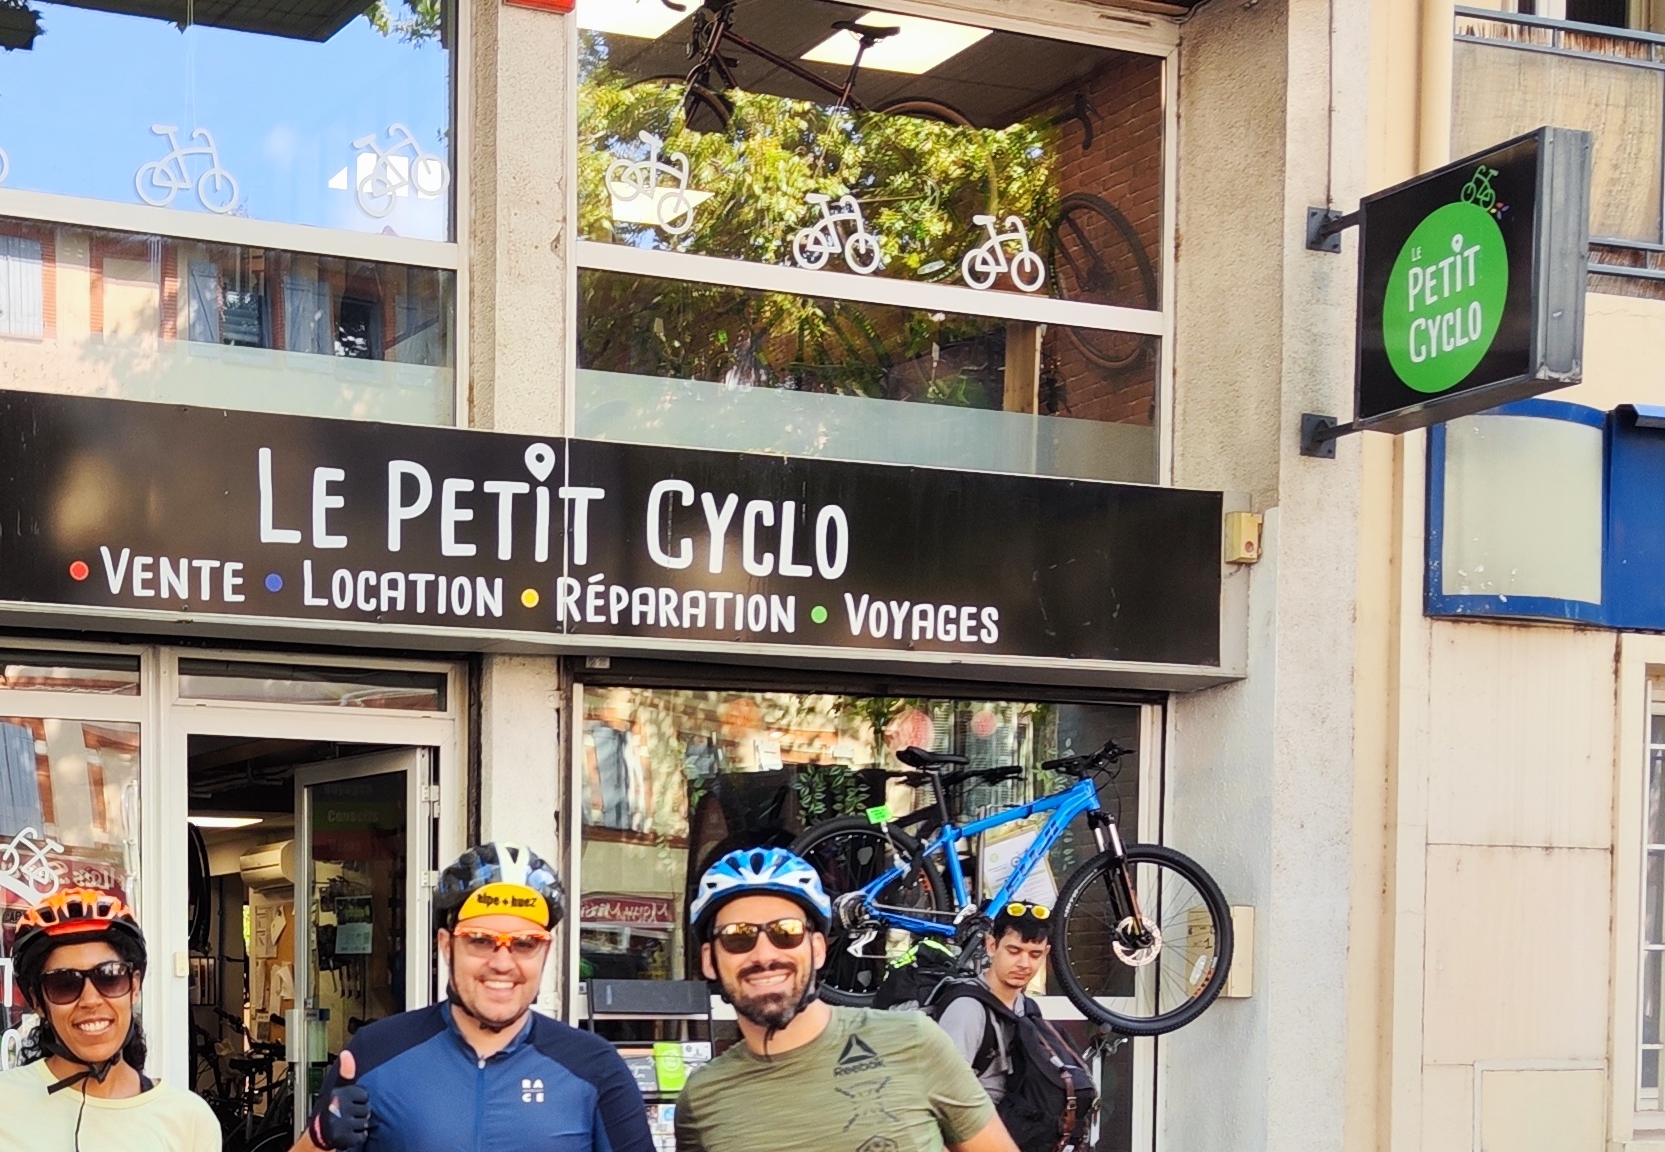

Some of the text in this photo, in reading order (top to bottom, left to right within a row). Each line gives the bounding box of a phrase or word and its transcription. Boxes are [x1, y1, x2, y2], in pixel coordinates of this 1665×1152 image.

[1412, 246, 1422, 261] LE
[1409, 301, 1482, 363] CYCLO
[258, 447, 348, 549] LE
[647, 479, 849, 580] CYCLO
[100, 546, 999, 644] VENTE LOCATION RÉPARATION VOYAGES
[834, 1057, 885, 1077] Reebok
